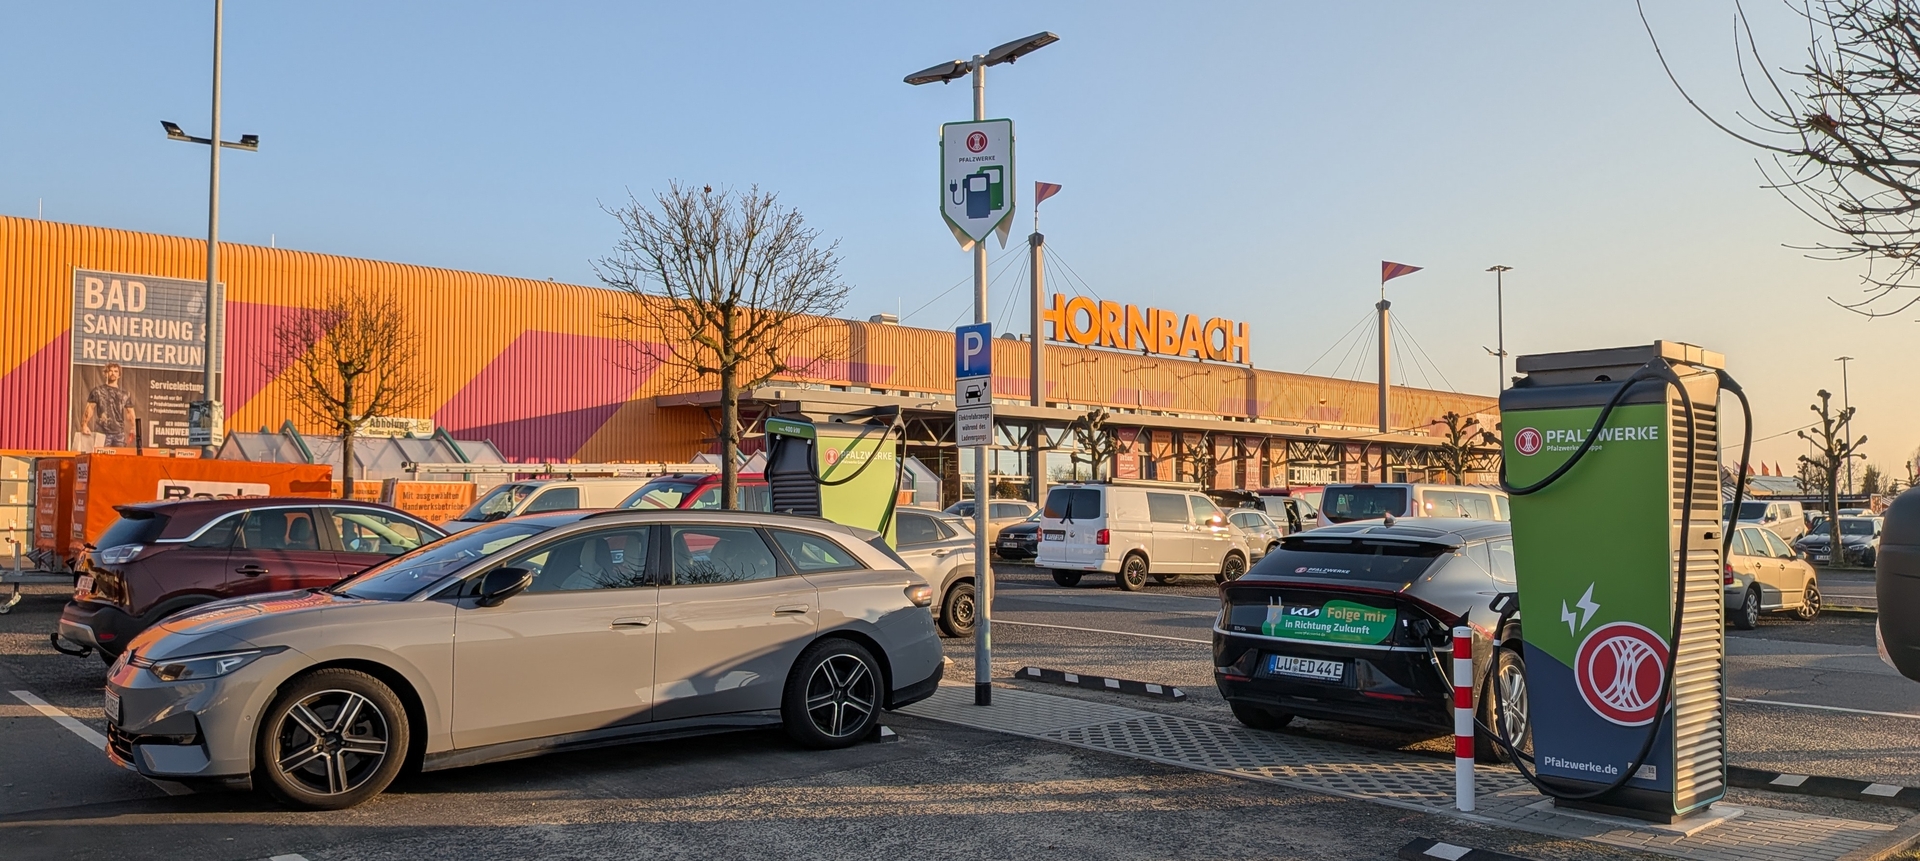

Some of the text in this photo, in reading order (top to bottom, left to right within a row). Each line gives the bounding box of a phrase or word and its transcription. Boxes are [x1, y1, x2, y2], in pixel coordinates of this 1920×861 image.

[84, 276, 147, 313] BAD
[83, 313, 193, 341] SANIERUNG
[1043, 293, 1250, 364] HORNBACH
[83, 338, 205, 366] RENOVIERUN
[963, 331, 983, 371] P
[151, 380, 204, 393] Serviceleistung
[959, 413, 989, 421] Elektrofahrzeuge
[155, 427, 189, 436] HANDWER
[369, 418, 410, 431] Abholung
[962, 423, 978, 431] während
[166, 437, 189, 446] SERVI
[1546, 426, 1659, 443] PFALWERKE
[840, 450, 893, 461] PFALZWRKE
[1294, 466, 1332, 484] EINGANG
[402, 491, 414, 499] Mit
[430, 513, 441, 521] der
[1307, 567, 1351, 575] PFALZWERKE
[1327, 607, 1387, 622] Folge mir
[1285, 620, 1371, 635] in Richtung Zukunft
[1544, 756, 1618, 775] Pfalzwerke.de
